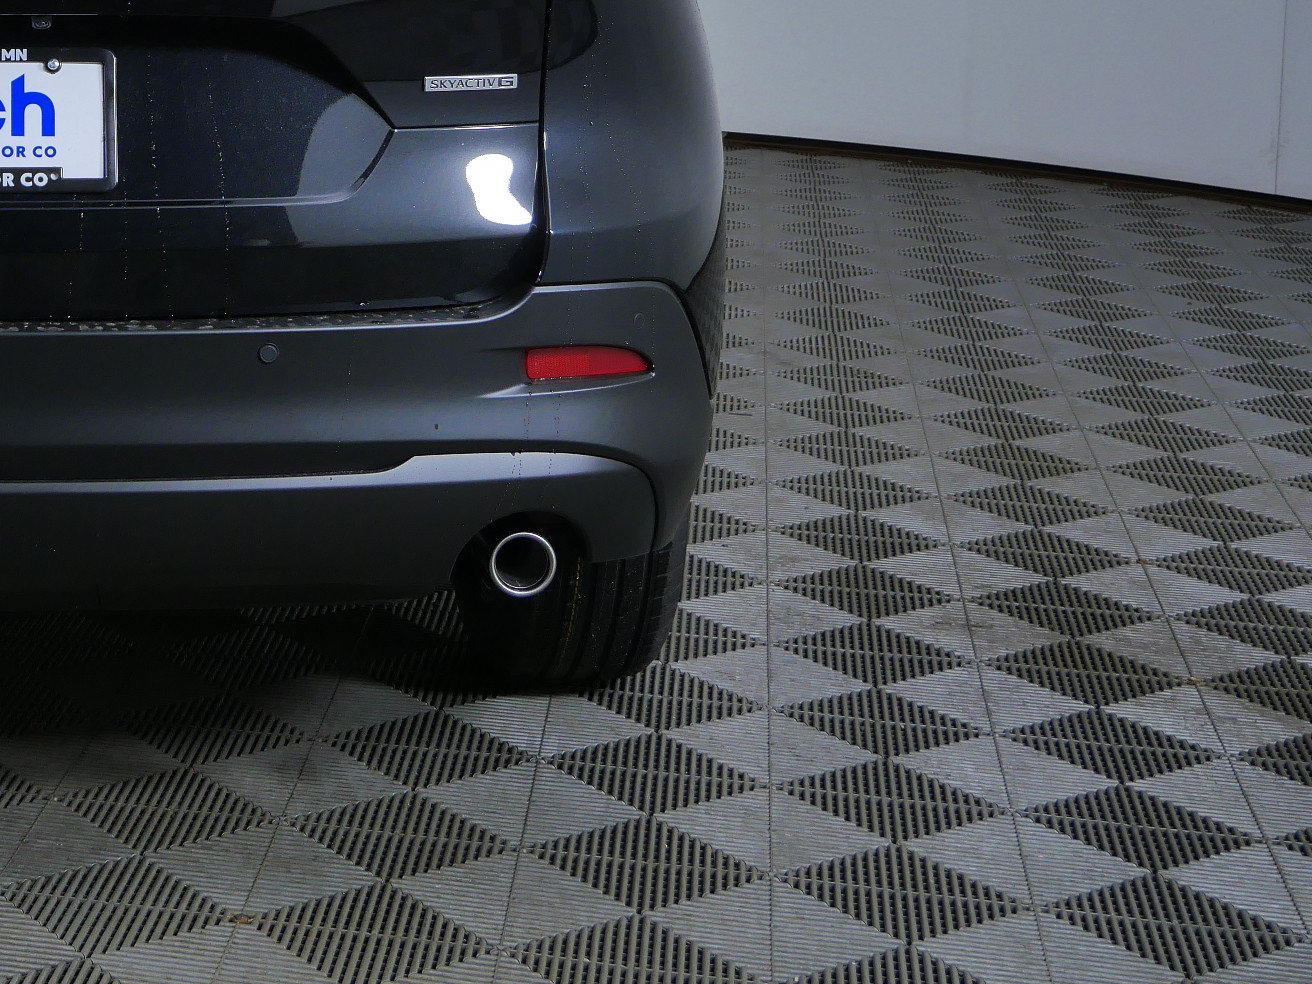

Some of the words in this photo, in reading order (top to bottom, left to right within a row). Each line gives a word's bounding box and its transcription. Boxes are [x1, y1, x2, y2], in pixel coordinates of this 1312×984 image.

[1, 49, 28, 61] MN
[32, 145, 57, 158] CO
[20, 172, 49, 188] CO
